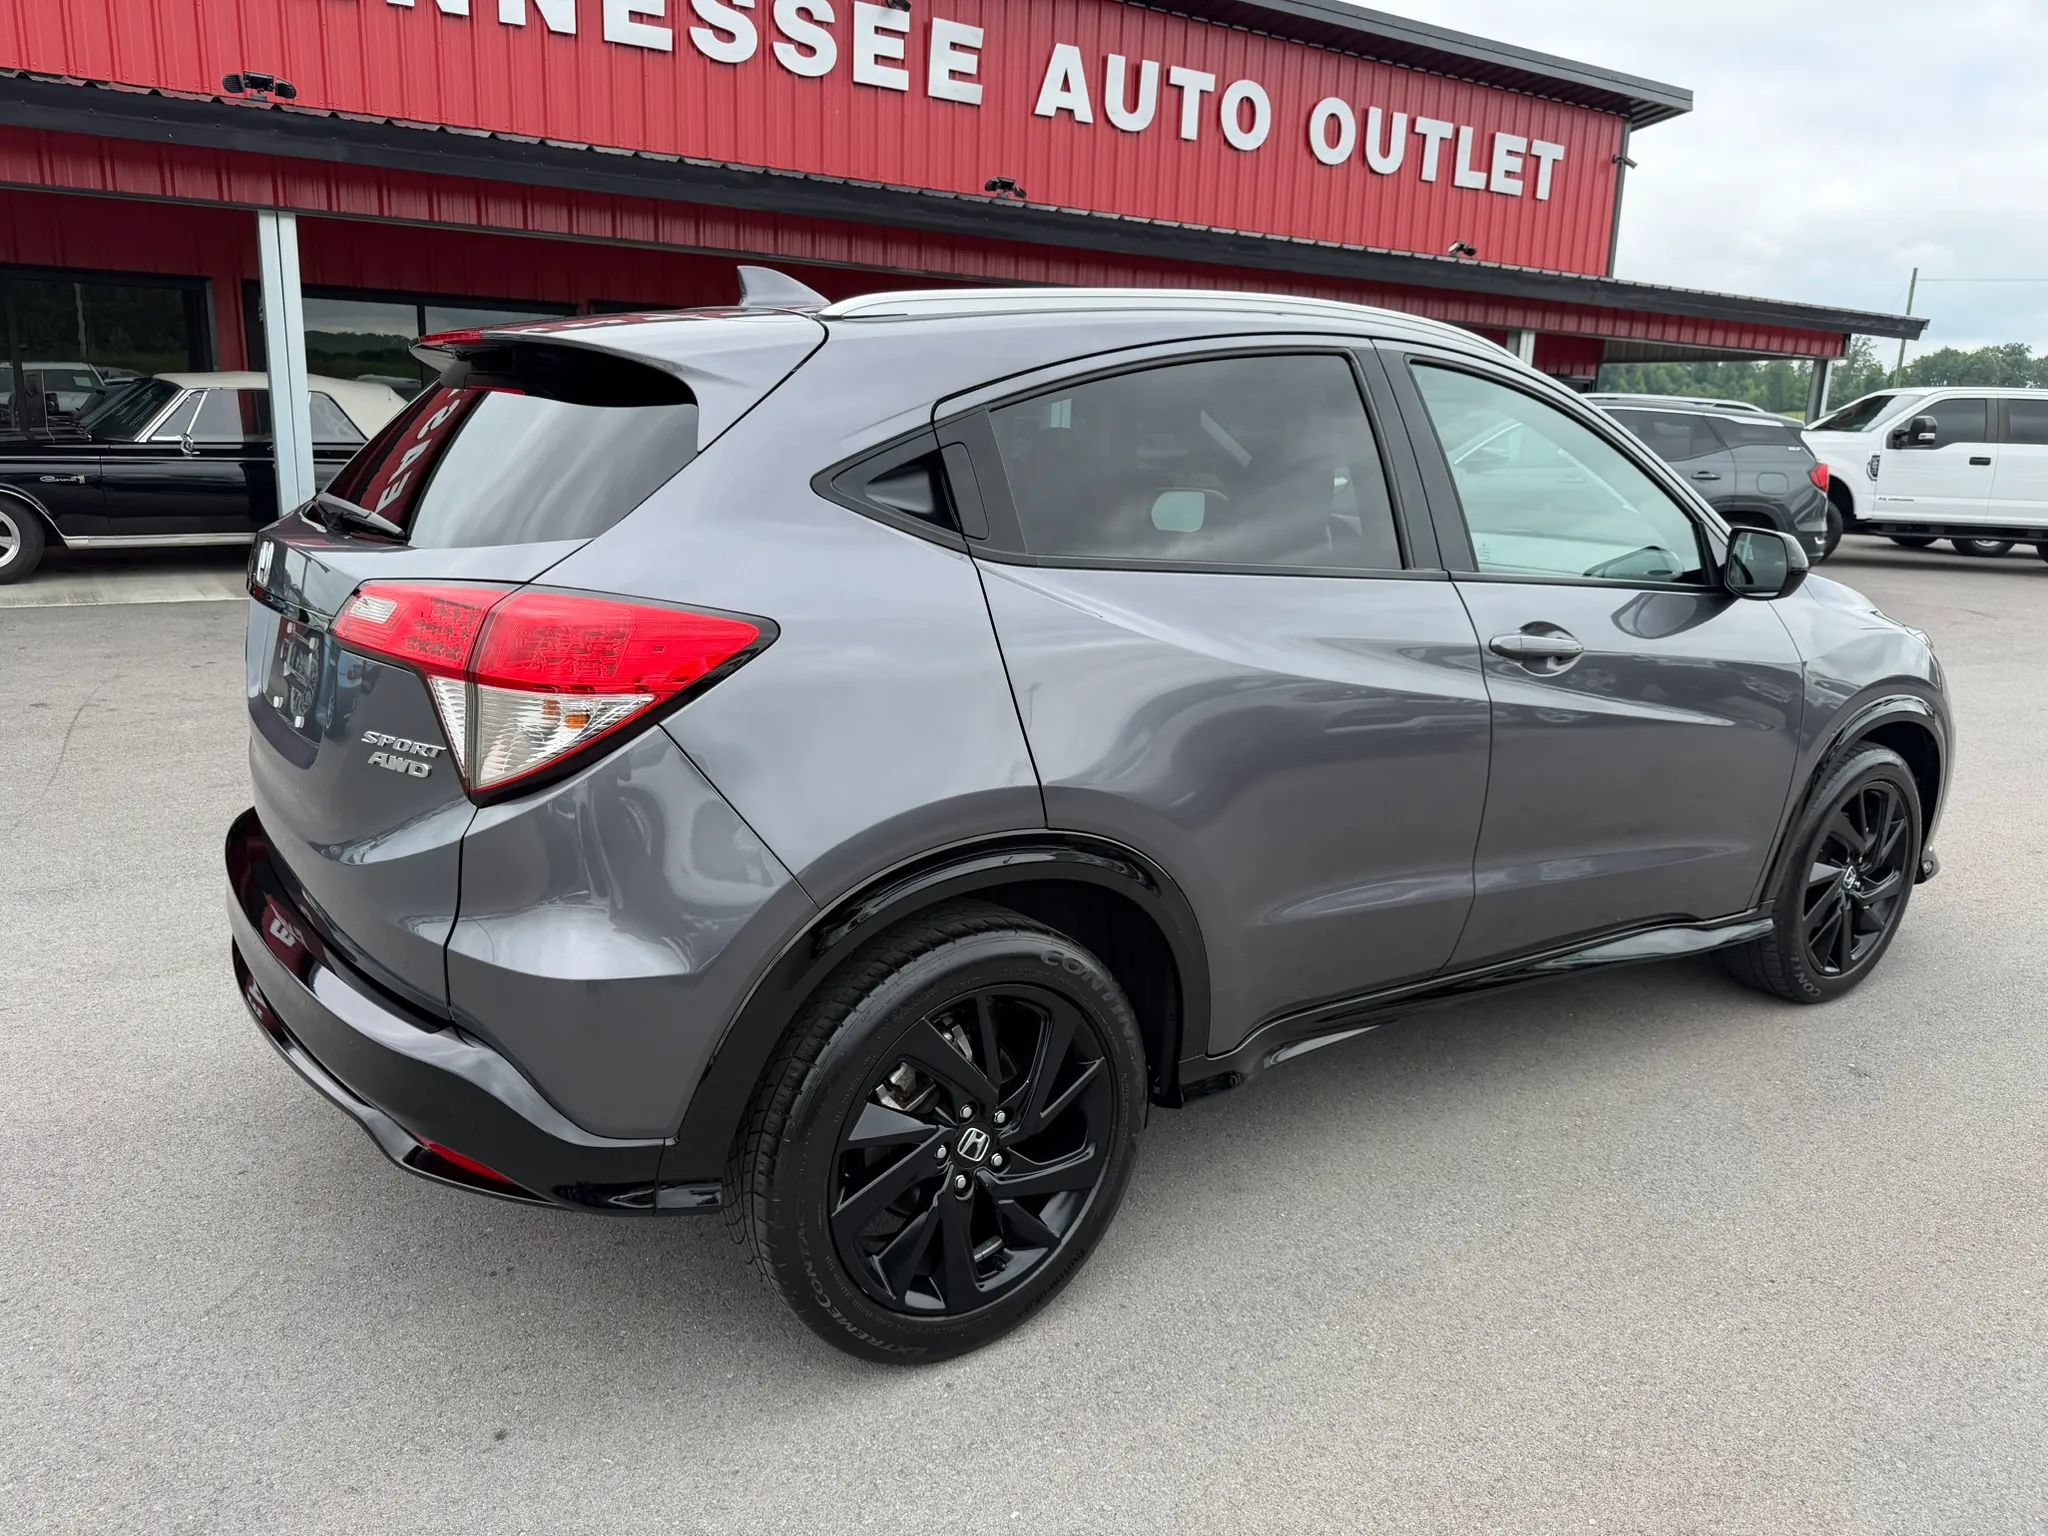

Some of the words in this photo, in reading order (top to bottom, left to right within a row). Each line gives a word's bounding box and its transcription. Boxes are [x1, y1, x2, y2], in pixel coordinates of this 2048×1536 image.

[386, 0, 985, 106] ESSEE
[1034, 42, 1272, 152] AUTO
[1309, 97, 1565, 201] OUTLET
[361, 730, 447, 759] SPORT
[368, 751, 432, 779] AWD
